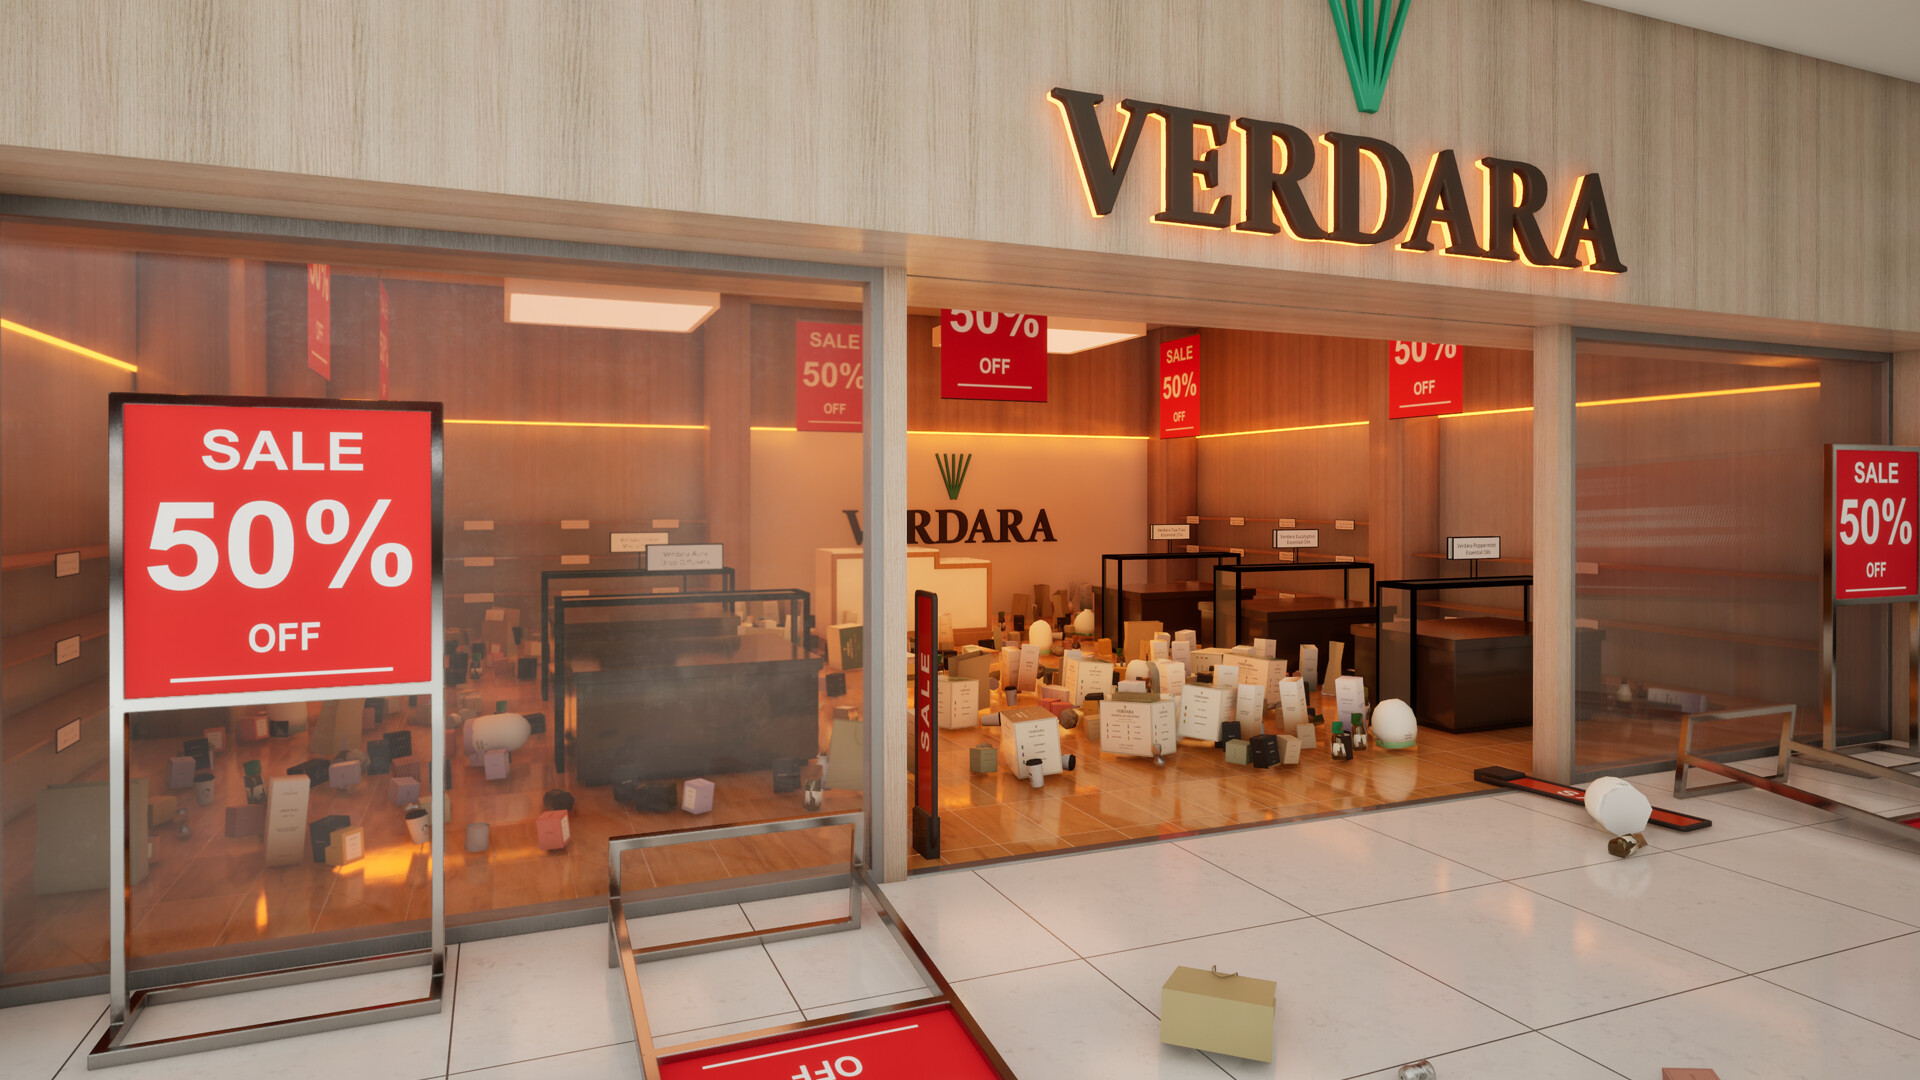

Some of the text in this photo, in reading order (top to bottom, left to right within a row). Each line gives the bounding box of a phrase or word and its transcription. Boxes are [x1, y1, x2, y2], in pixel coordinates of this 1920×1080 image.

[1047, 86, 1628, 275] VERDARA
[949, 308, 1040, 338] 50%
[809, 331, 861, 350] SALE
[1165, 344, 1194, 365] SALE
[1394, 340, 1457, 365] 50%
[802, 360, 864, 389] 50%
[979, 357, 1011, 376] OFF
[1162, 370, 1197, 400] 50%
[1413, 379, 1436, 396] OFF
[823, 402, 847, 415] OFF
[1173, 410, 1187, 423] OFF
[201, 428, 364, 472] SALE
[1854, 461, 1899, 485] SALE
[842, 508, 1058, 545] VRDARA
[1839, 497, 1913, 546] 50%
[146, 498, 413, 592] 50%
[1866, 561, 1887, 579] OFF
[248, 621, 321, 654] OFF
[920, 652, 931, 753] SALE
